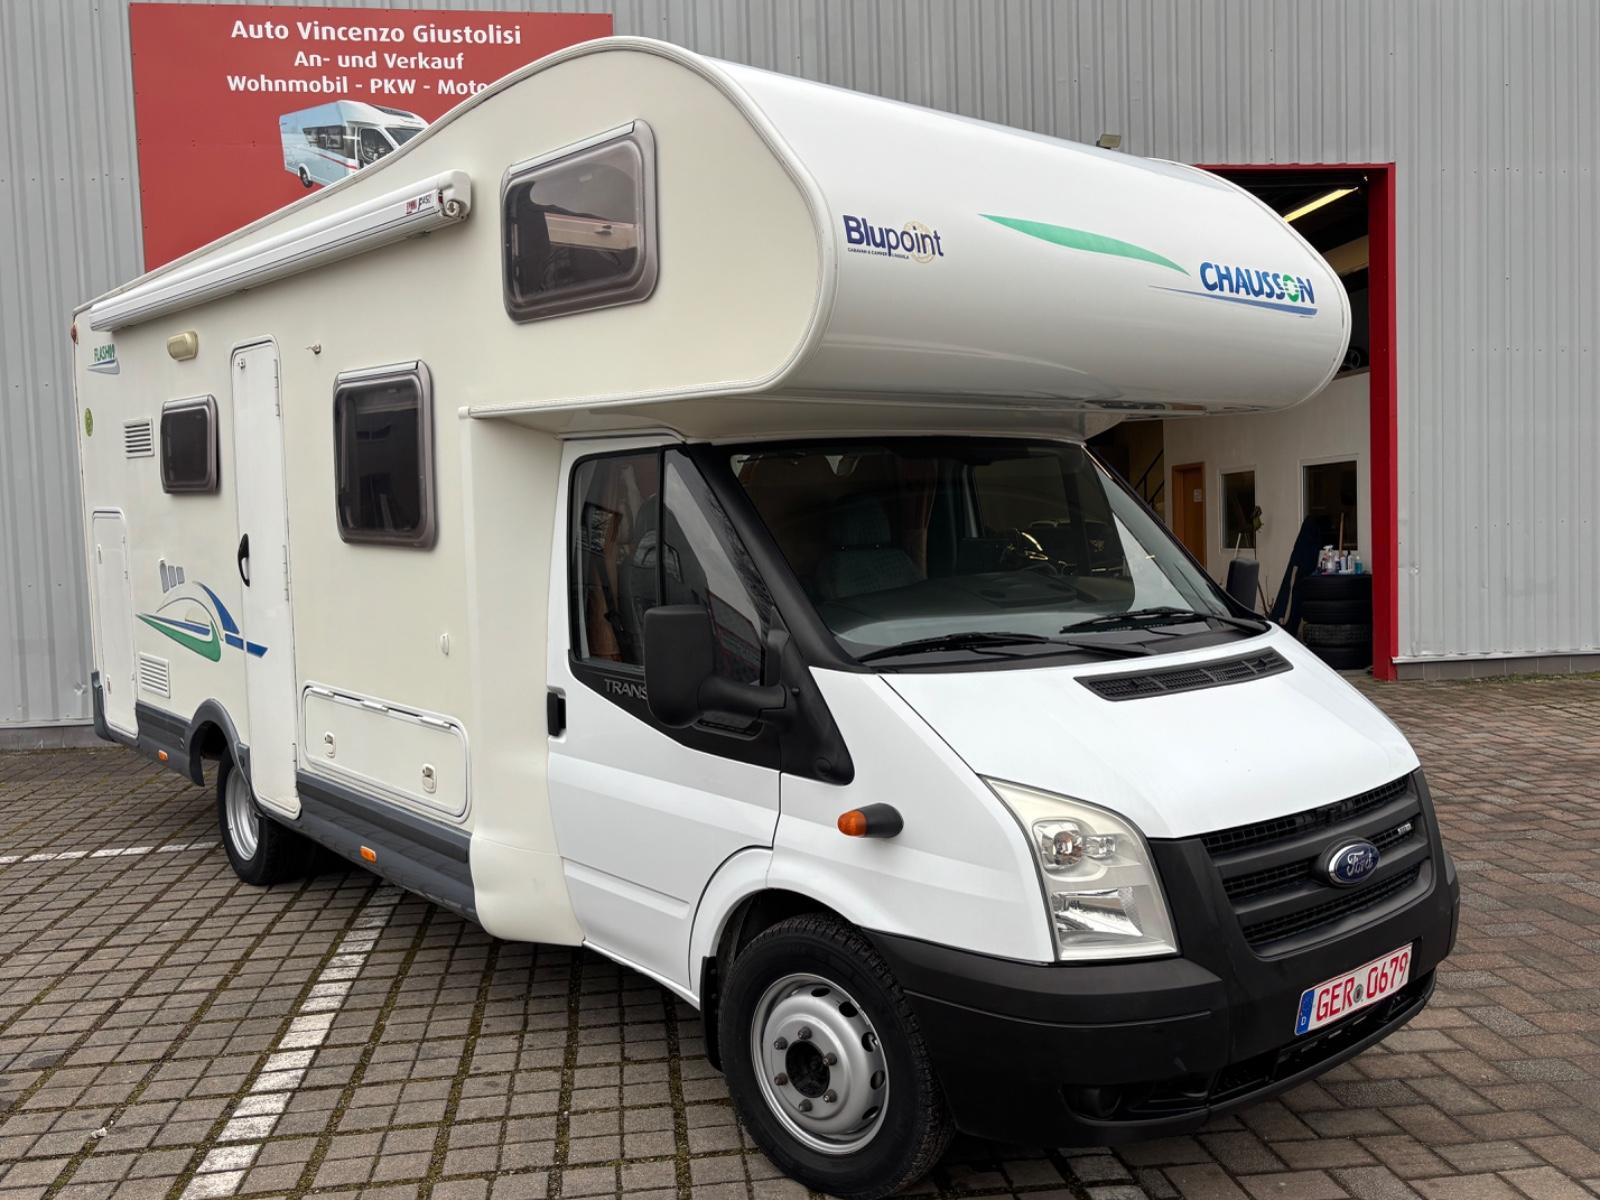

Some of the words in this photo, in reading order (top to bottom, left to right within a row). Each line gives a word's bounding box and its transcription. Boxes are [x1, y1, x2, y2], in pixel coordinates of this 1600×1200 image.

[230, 20, 289, 40] Auto
[296, 21, 405, 43] Vincenzo
[413, 23, 521, 45] Giustolisi
[294, 51, 331, 67] An-
[337, 51, 377, 69] und
[383, 52, 464, 70] Verkauf
[226, 74, 348, 94] Wohnmobil
[370, 78, 416, 94] PKW
[842, 214, 944, 257] Blupoint
[1199, 261, 1315, 305] CHAUSSON
[1346, 848, 1374, 876] Ford
[1315, 976, 1355, 1022] GER
